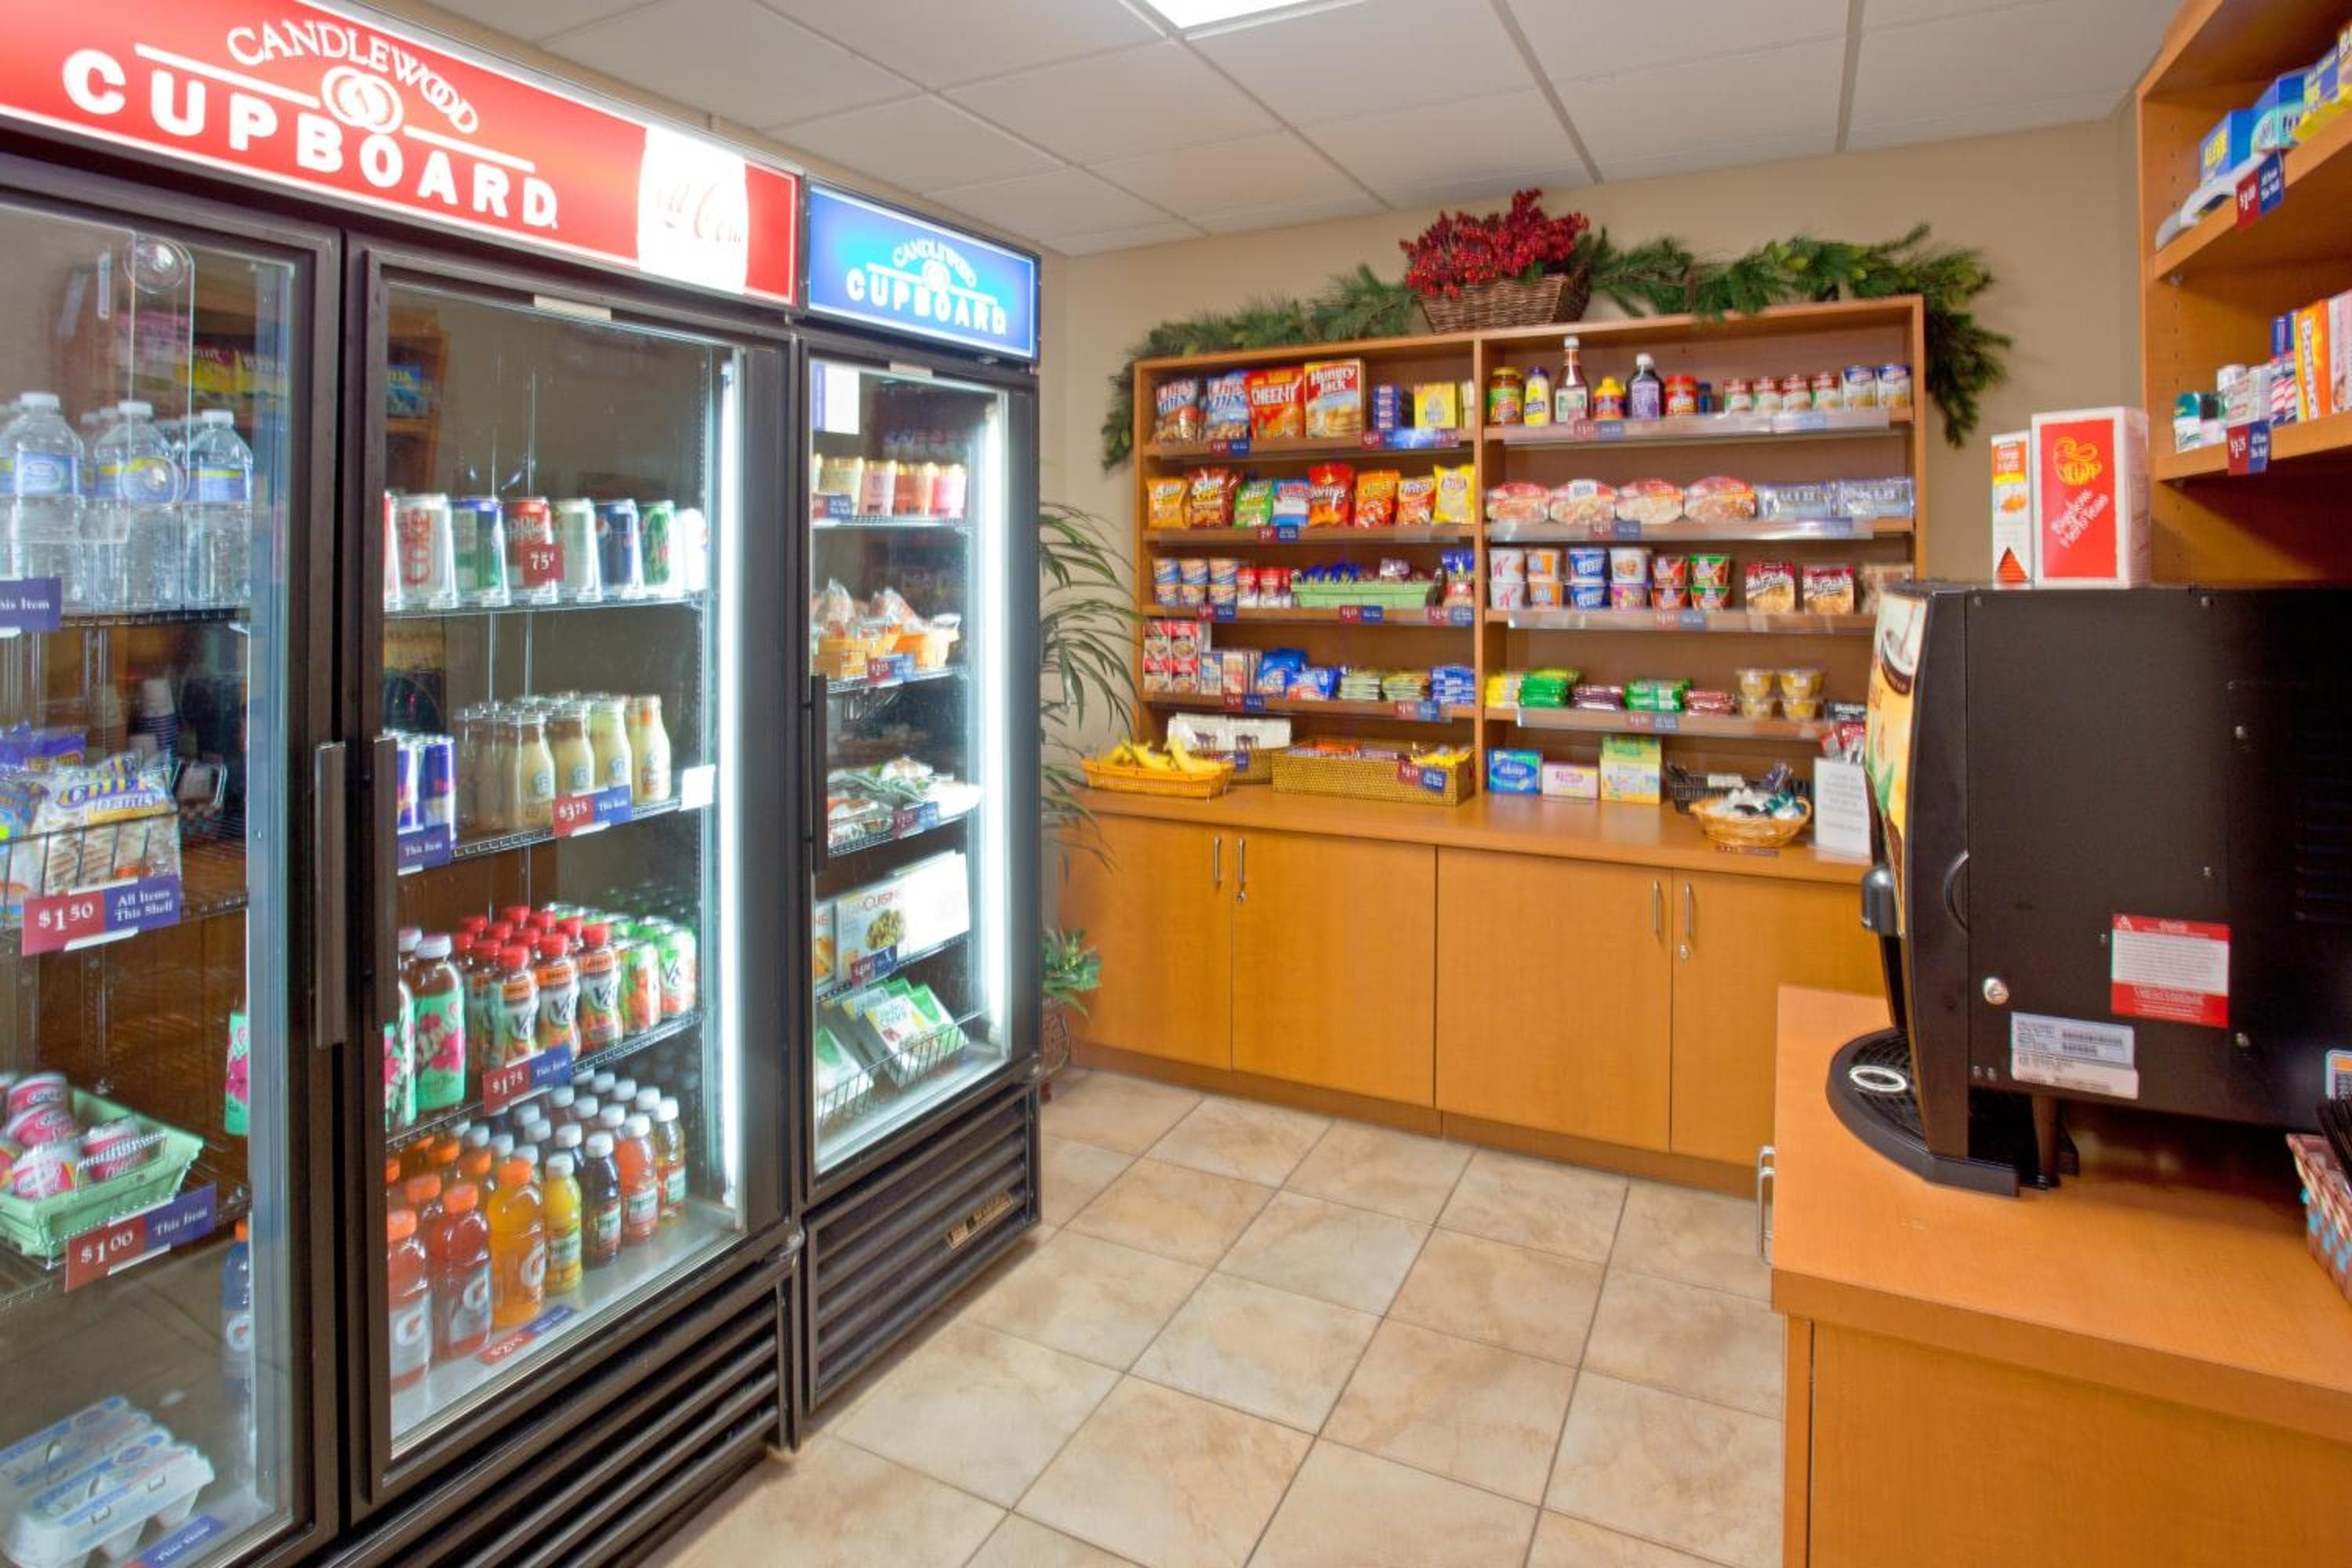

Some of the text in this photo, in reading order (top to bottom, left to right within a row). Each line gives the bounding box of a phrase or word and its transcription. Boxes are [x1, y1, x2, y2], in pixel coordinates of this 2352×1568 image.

[227, 18, 480, 135] CANDLEWOOD
[62, 47, 558, 230] CUPBOARD
[892, 238, 977, 289] CANDLEWOOD
[846, 268, 1007, 336] CUPBOARD
[20, 597, 50, 611] Item
[114, 900, 174, 922] This Shelf
[117, 894, 136, 908] All
[138, 889, 171, 905] Items
[81, 1207, 209, 1265] $100 This Item
